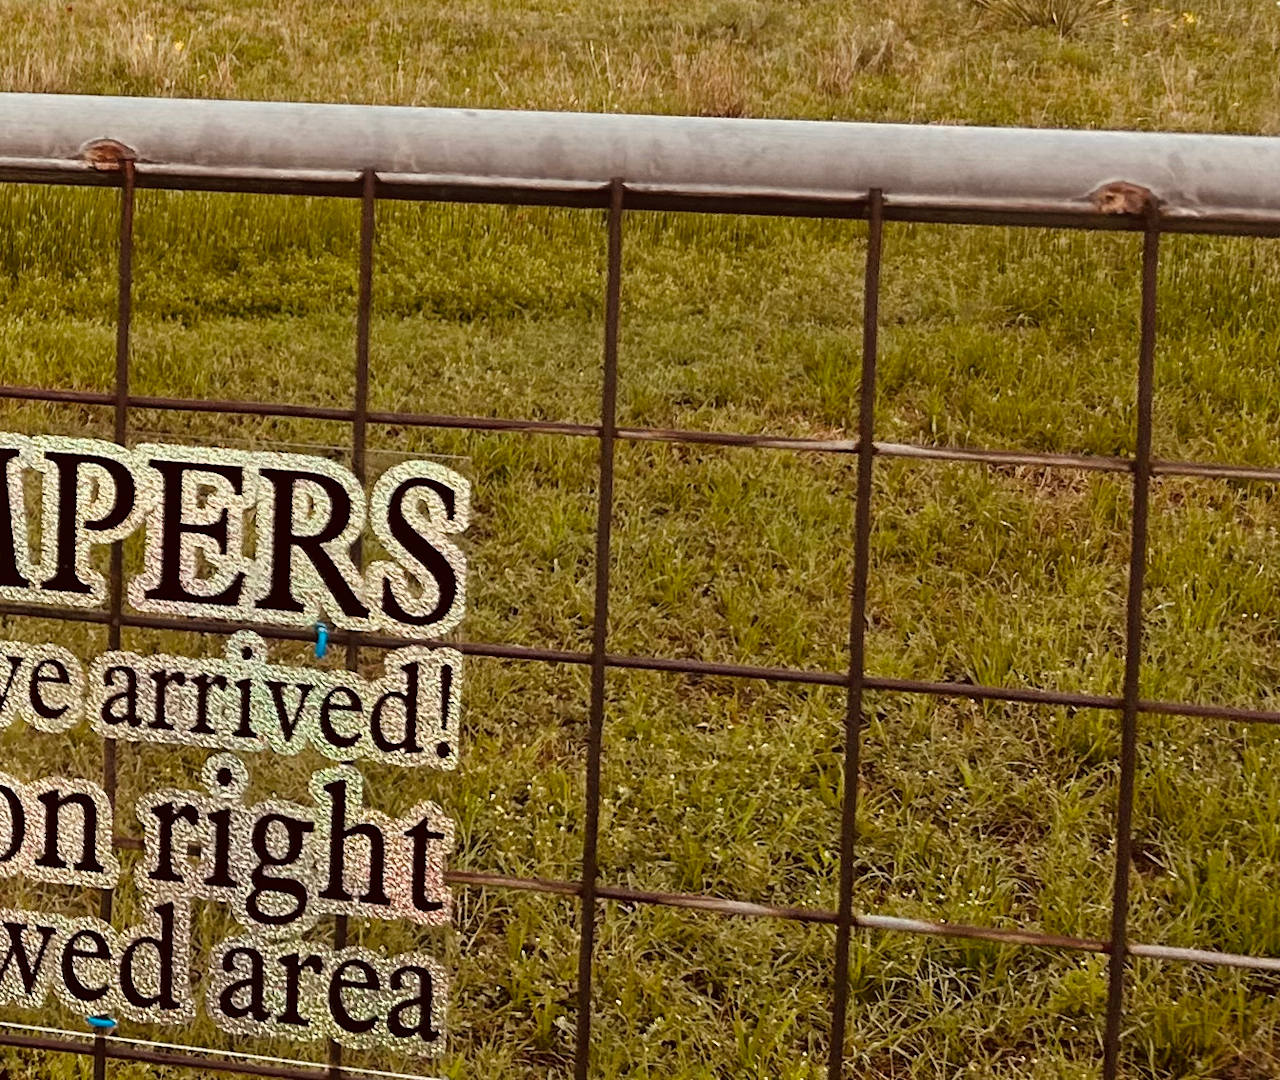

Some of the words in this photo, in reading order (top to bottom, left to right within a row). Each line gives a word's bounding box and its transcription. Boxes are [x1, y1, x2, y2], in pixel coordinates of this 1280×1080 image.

[101, 645, 454, 758] arrived!
[151, 768, 444, 924] right
[220, 947, 439, 1043] area
